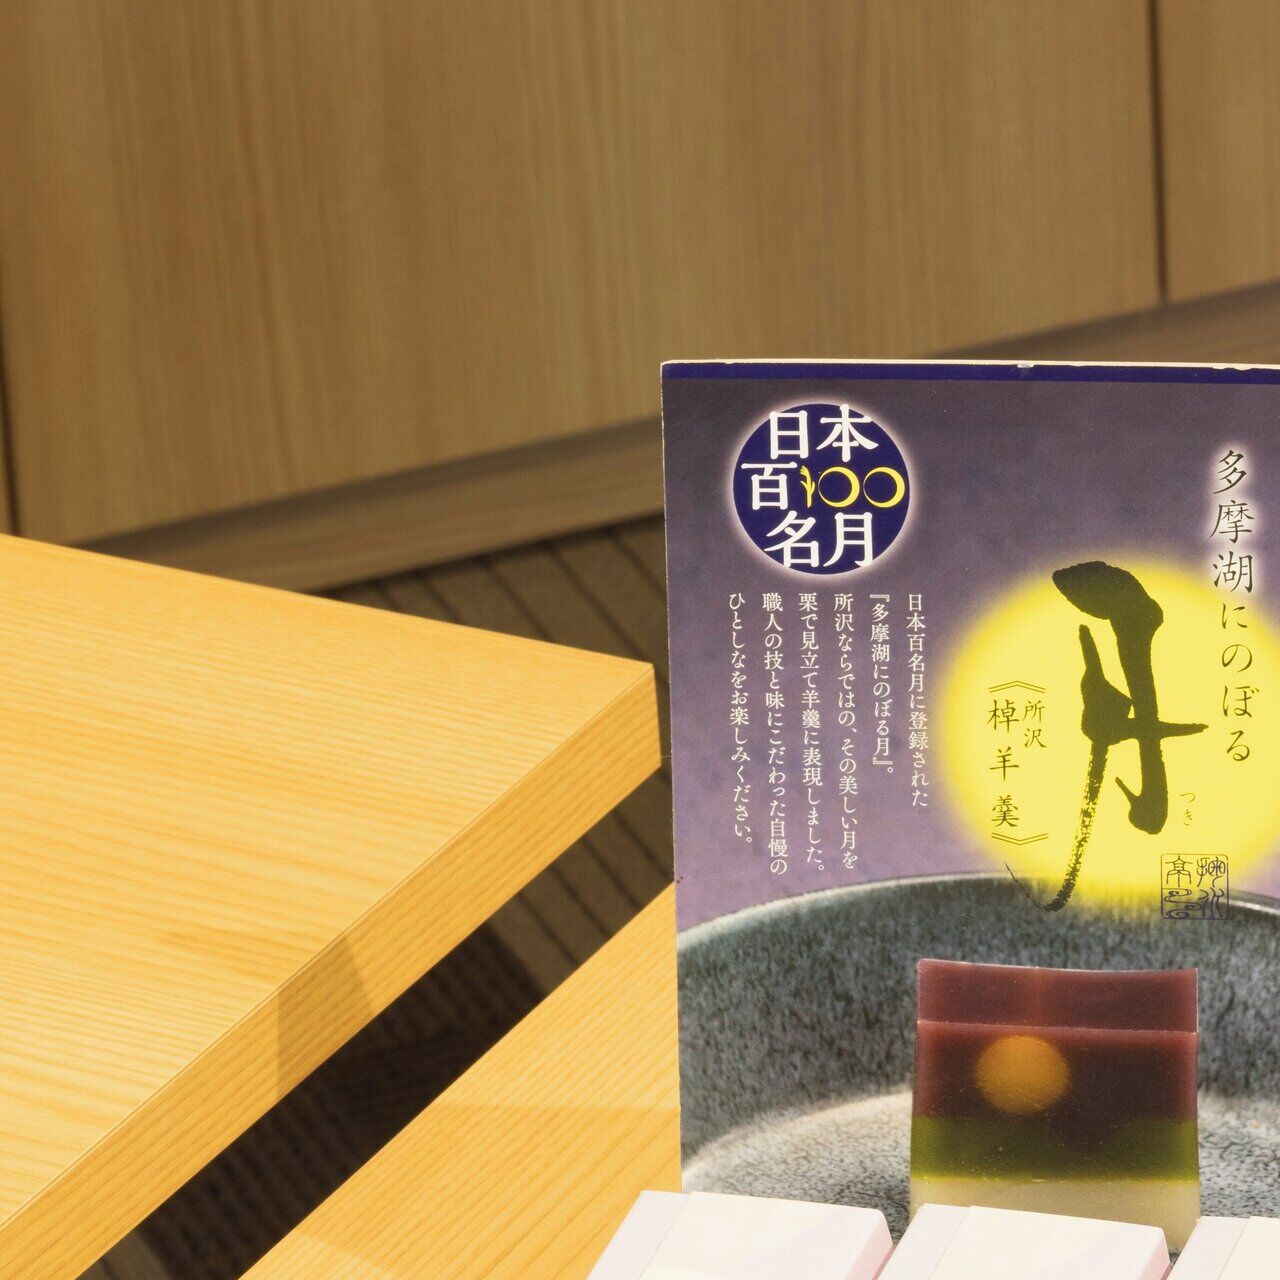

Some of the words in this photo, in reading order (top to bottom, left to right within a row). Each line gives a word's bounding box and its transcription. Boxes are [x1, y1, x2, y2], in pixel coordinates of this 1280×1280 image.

[764, 510, 873, 567] 名月
[769, 404, 879, 462] 日本
[729, 593, 752, 843] ひとしなをお楽しみください。
[762, 592, 788, 875] 職人の技と味にこだわった自慢の
[798, 592, 824, 871] 栗で見立て羊羹に表現しました。
[834, 593, 858, 869] 所沢ならではの、その美しい月を
[906, 593, 929, 807] 日本百名月に登録された
[1005, 559, 1209, 911] 月
[1210, 449, 1260, 764] 多摩湖にのぼる
[1180, 791, 1195, 826] つき
